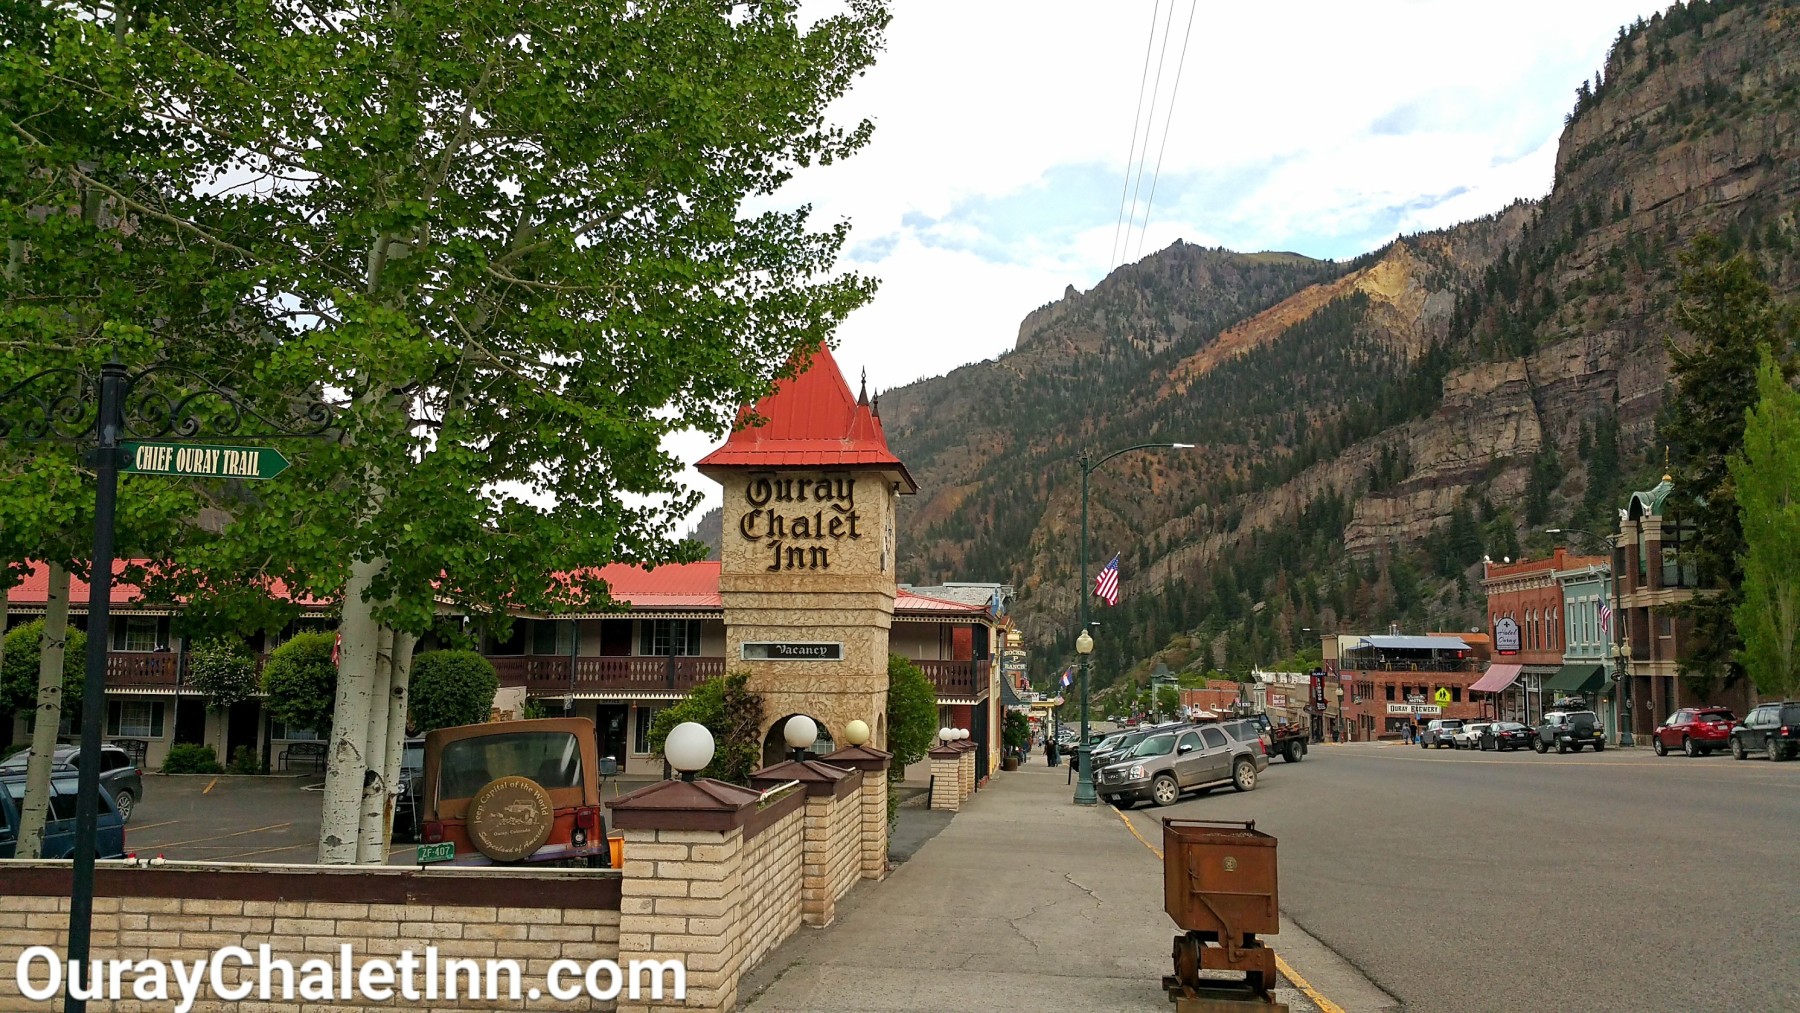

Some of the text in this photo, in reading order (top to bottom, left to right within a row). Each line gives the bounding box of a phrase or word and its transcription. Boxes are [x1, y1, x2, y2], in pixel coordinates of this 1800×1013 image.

[136, 445, 260, 476] CHIEF OURAY TRAIL
[746, 478, 856, 514] Ouray
[740, 508, 862, 541] Chalet
[767, 540, 830, 571] Inn
[775, 644, 828, 659] Vacancy
[1498, 636, 1517, 644] Ouray
[474, 805, 485, 824] Jeep
[481, 782, 508, 804] Capital
[520, 783, 533, 792] the
[534, 790, 549, 816] World
[514, 845, 521, 853] of
[523, 825, 545, 849] America
